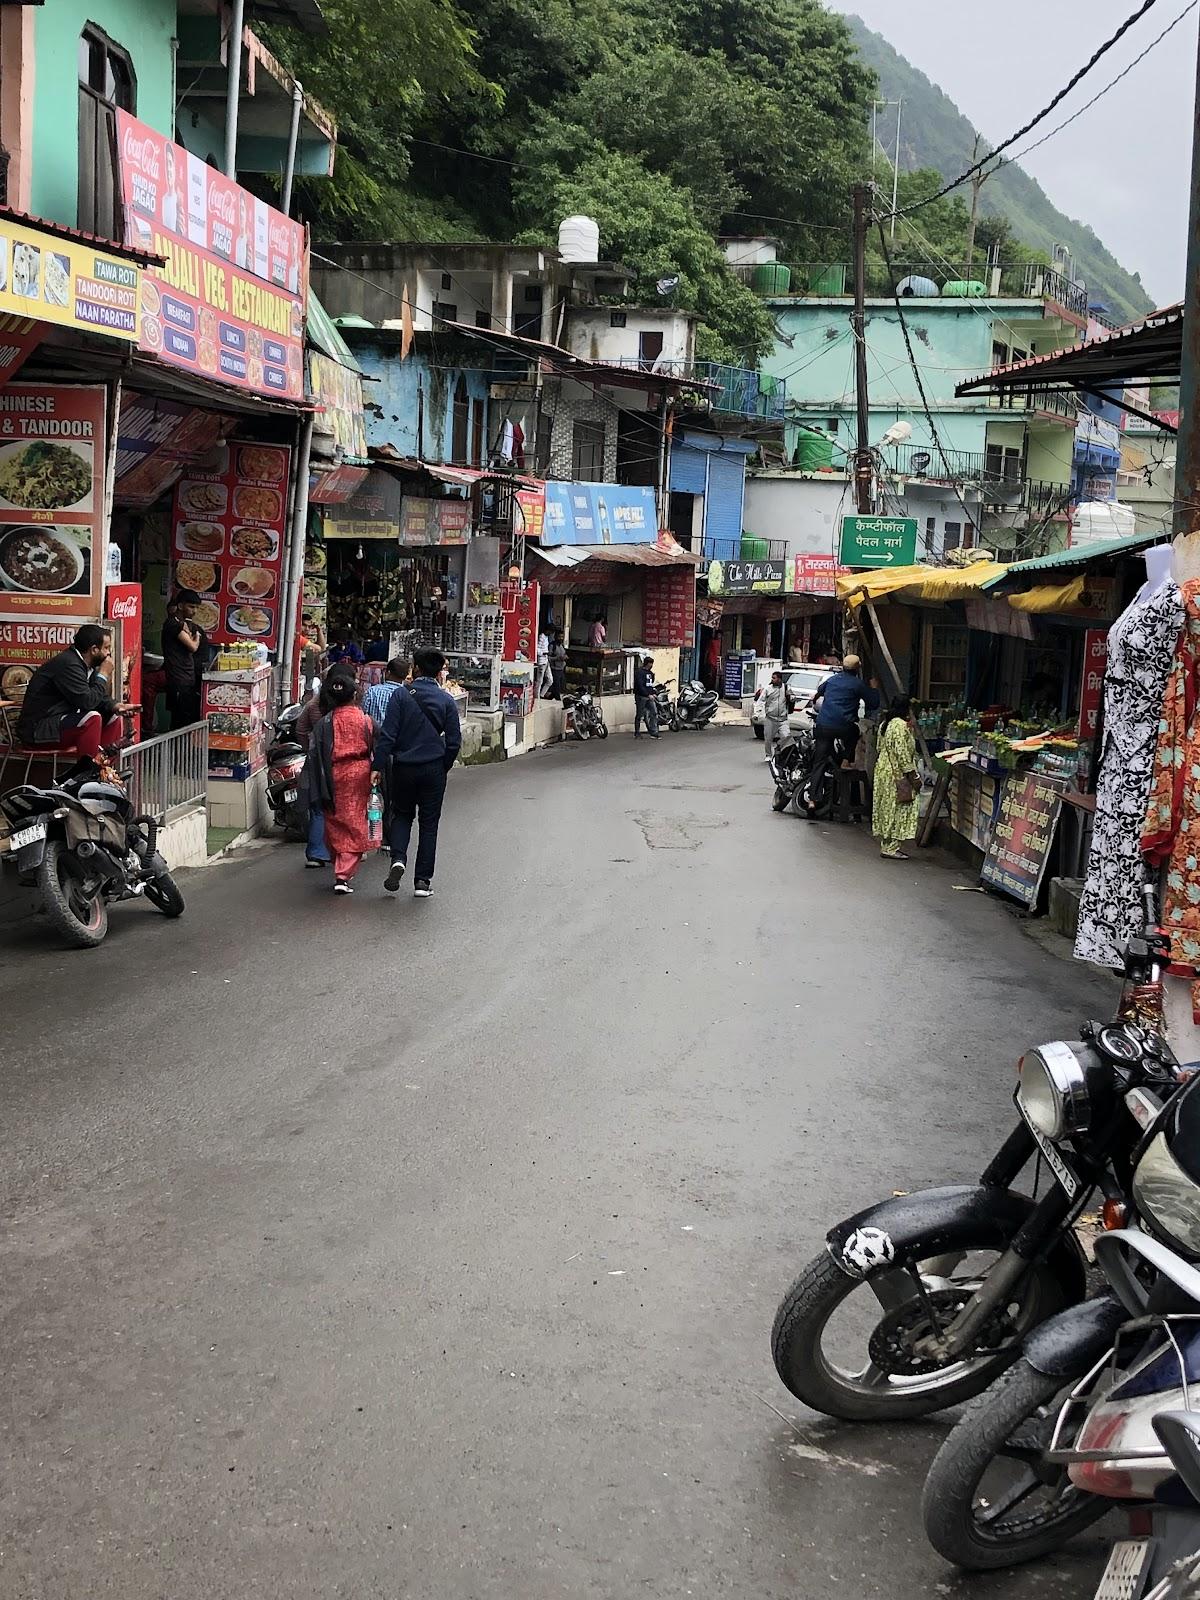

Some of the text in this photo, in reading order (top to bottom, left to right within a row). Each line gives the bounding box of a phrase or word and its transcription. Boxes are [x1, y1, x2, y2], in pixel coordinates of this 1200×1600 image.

[132, 185, 156, 213] JAGAO
[96, 261, 136, 287] TAWA ROTI
[77, 279, 136, 307] TANDOORI ROTI
[154, 232, 292, 337] ANJALI VEG. RESTAURANT
[75, 302, 99, 322] NAAN
[2, 418, 93, 436] & TANDOOR
[855, 534, 903, 548] पैदल मार्ग
[728, 563, 782, 581] The Hills Pizza
[17, 625, 79, 645] RESTAUR
